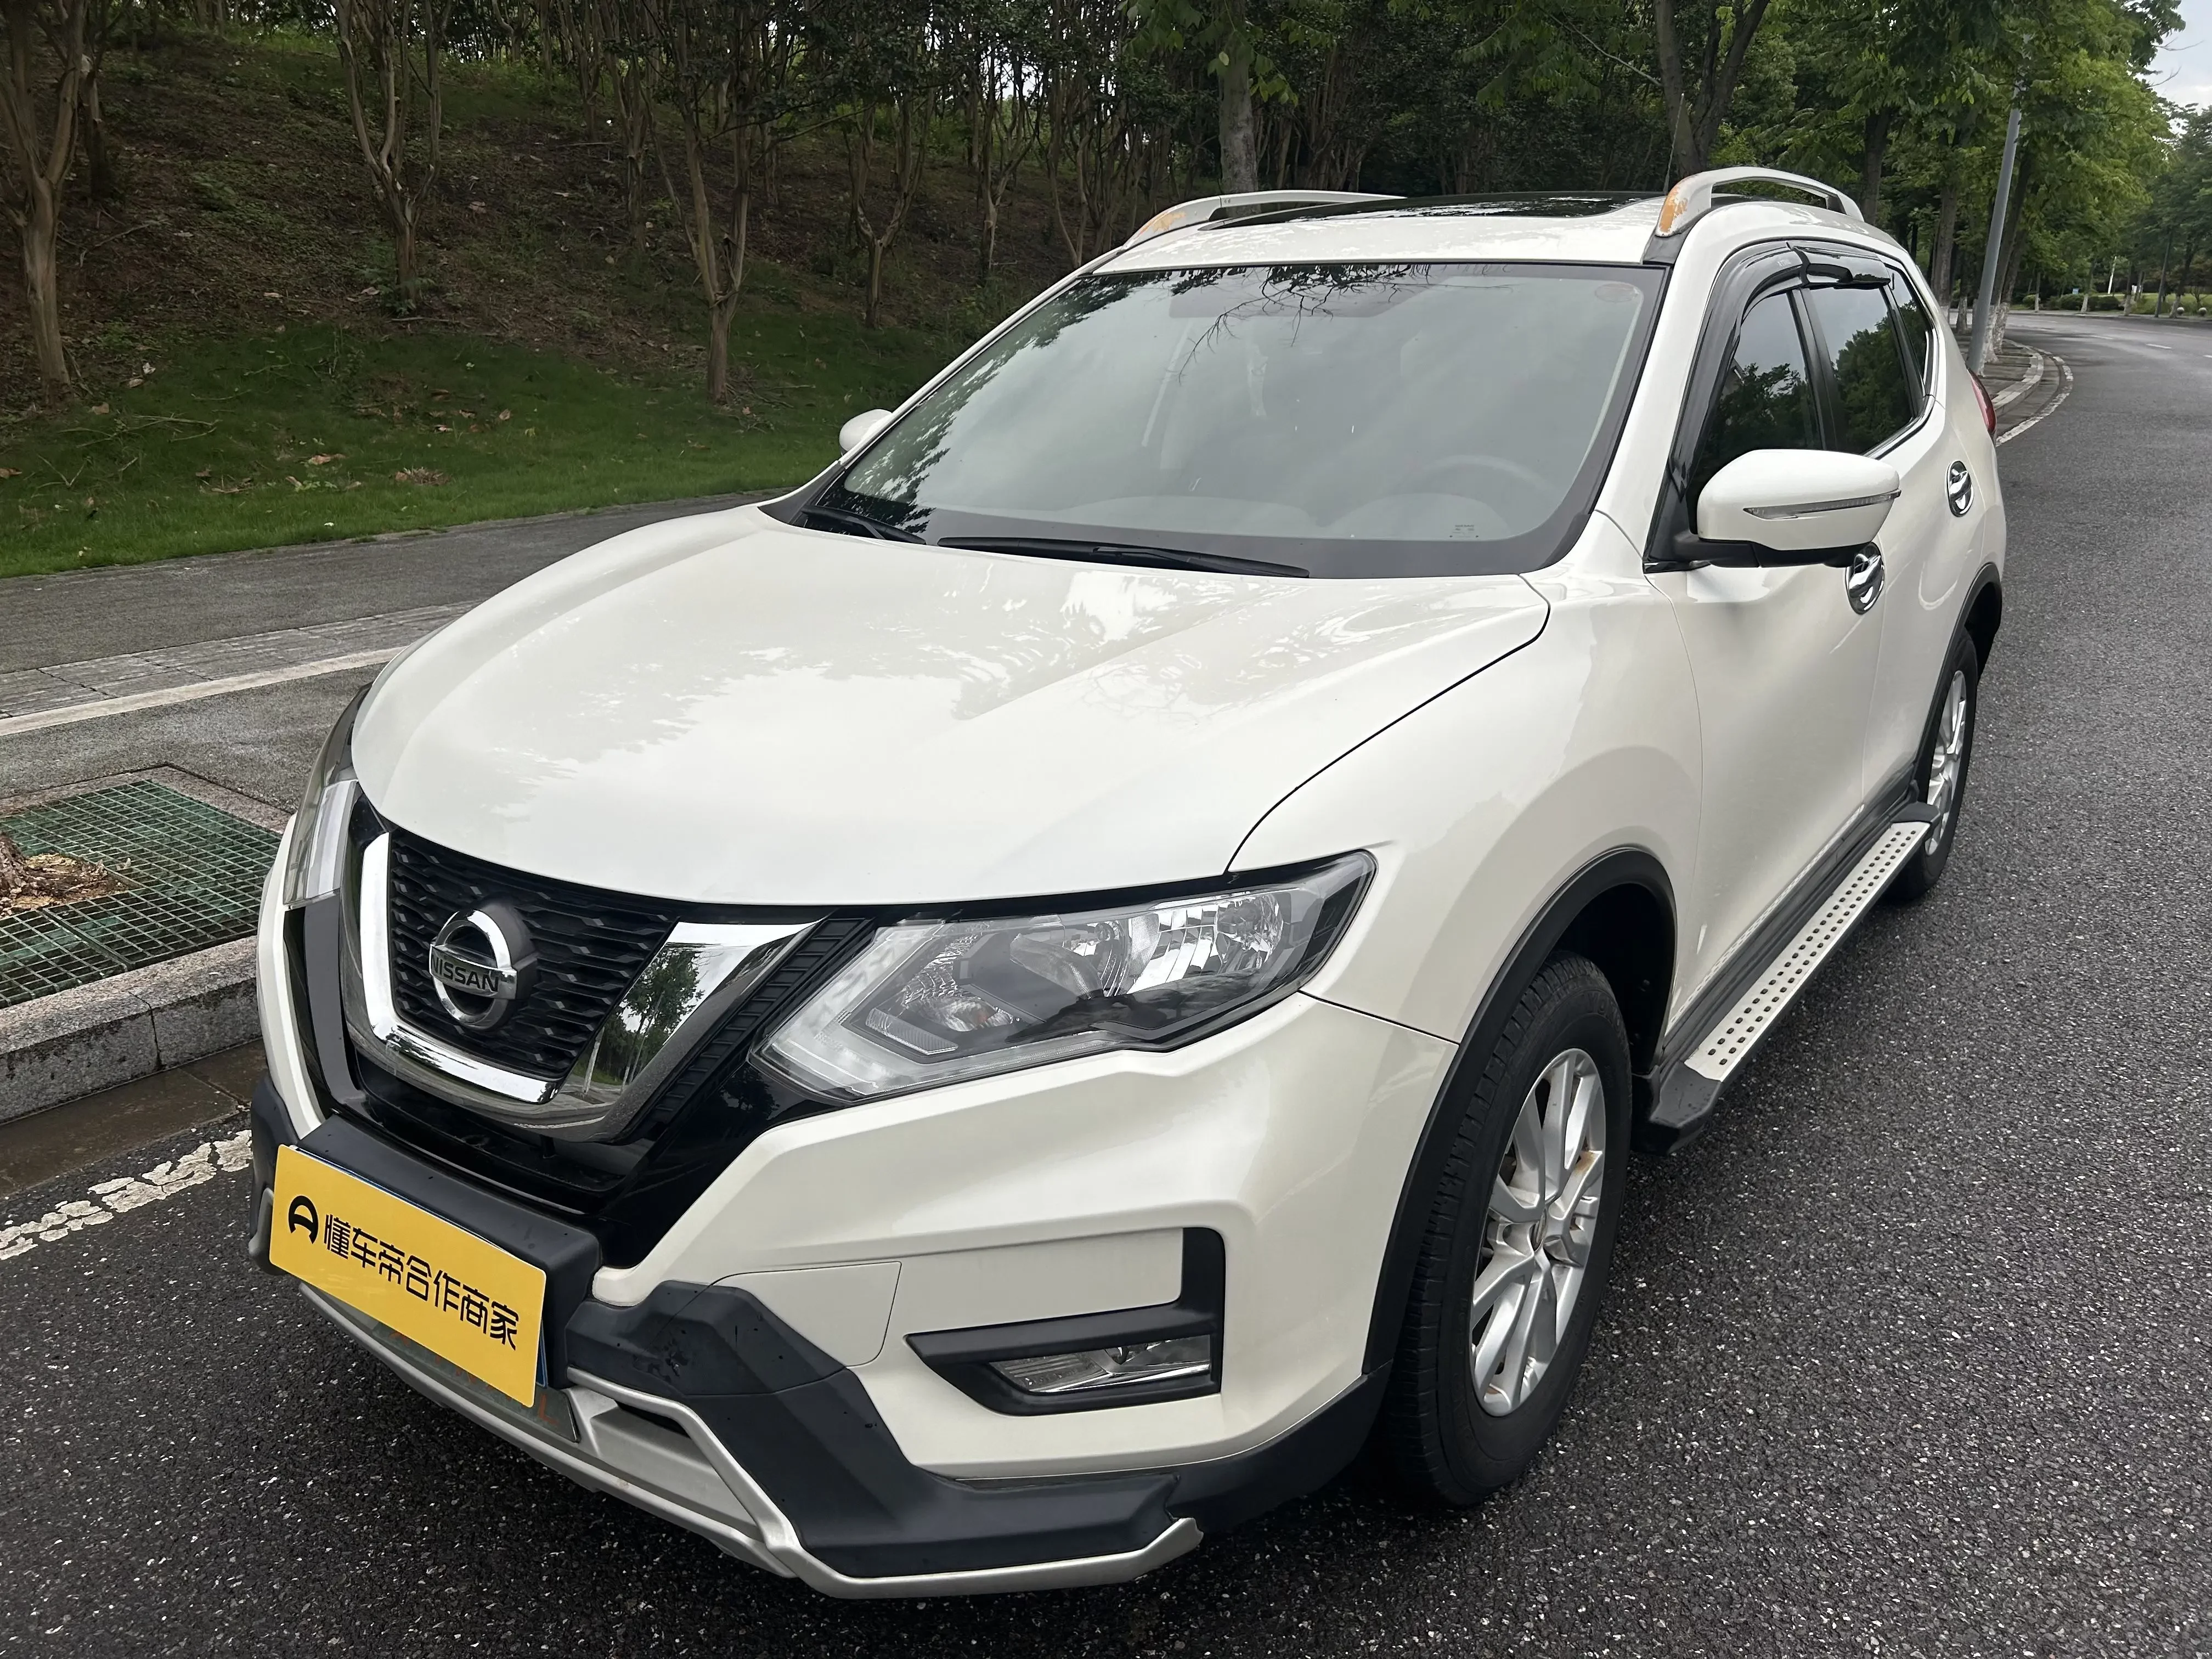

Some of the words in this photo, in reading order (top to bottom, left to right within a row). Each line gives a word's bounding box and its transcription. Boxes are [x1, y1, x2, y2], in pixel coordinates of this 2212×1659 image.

[431, 953, 499, 992] NISSAN
[324, 1214, 519, 1351] 懂车帝合作商家
